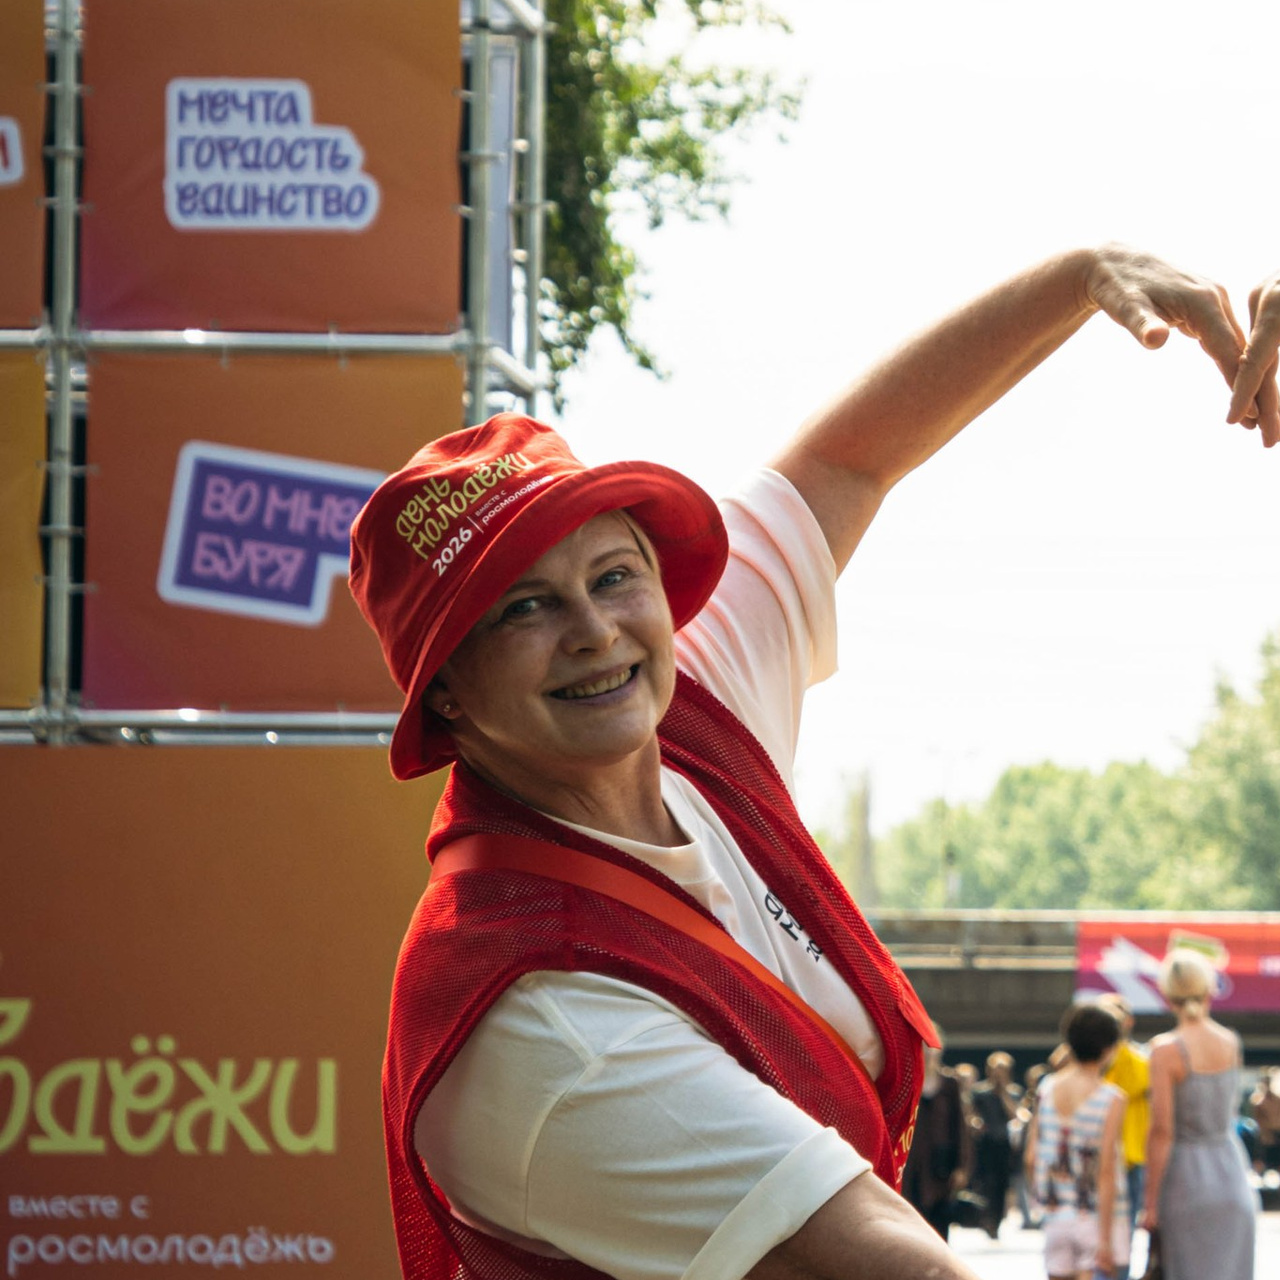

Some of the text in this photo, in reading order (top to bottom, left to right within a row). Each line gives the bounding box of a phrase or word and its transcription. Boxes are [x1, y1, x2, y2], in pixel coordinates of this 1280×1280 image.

[178, 136, 352, 172] ГОРДОСТЬ
[202, 474, 259, 525] ВО
[191, 531, 306, 592] БУРЯ
[432, 527, 473, 577] 2026
[8, 1195, 149, 1218] вместе с
[8, 1227, 335, 1277] росмолодёжь
